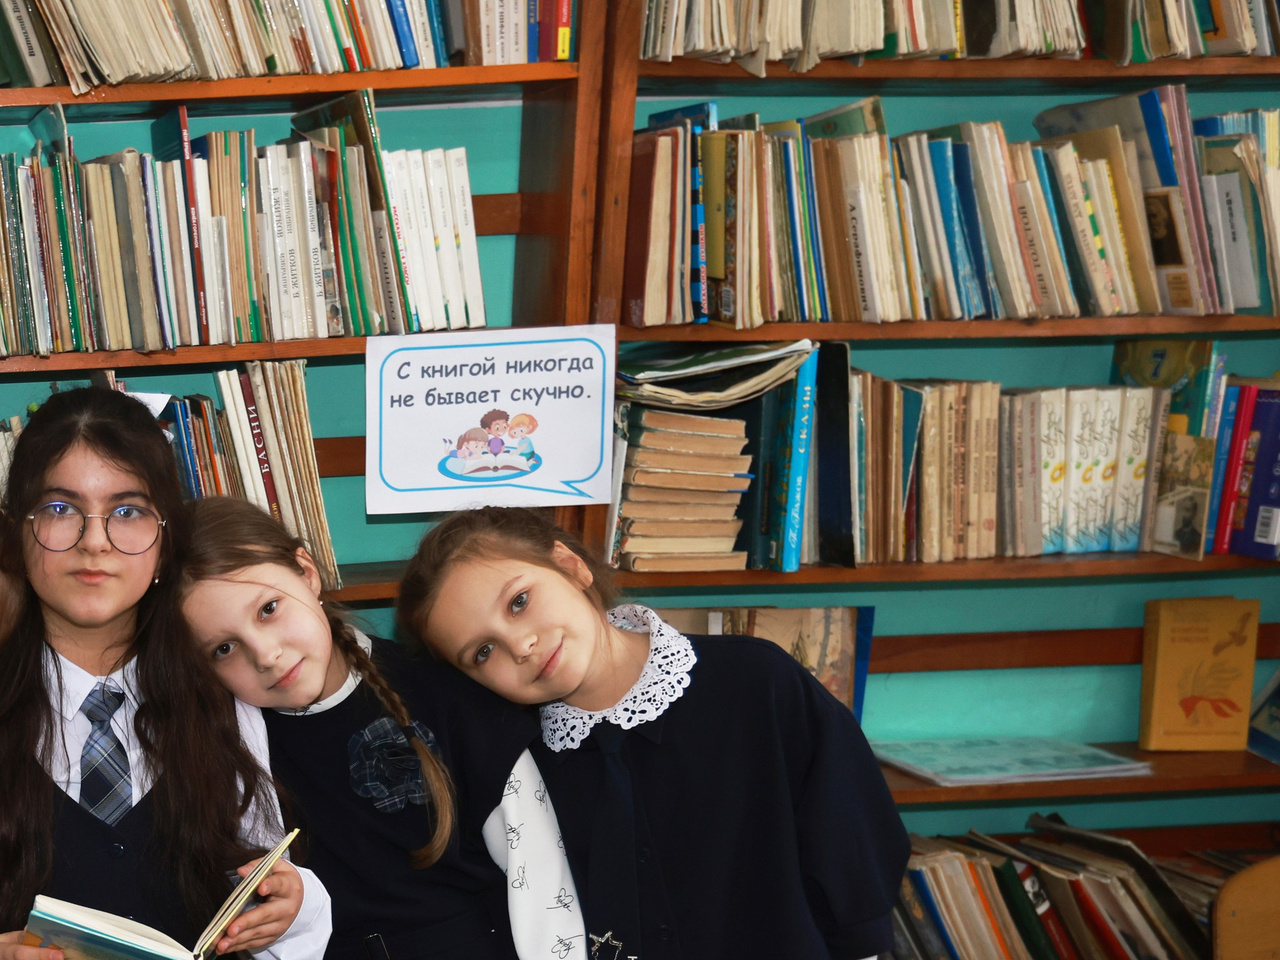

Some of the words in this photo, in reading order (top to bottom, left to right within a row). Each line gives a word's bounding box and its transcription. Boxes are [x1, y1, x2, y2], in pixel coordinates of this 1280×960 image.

[273, 197, 284, 240] ЖИТКОВ
[282, 190, 294, 235] ИЗБРАННОЕ
[306, 187, 317, 233] ИЗБРАННОЕ
[1017, 205, 1042, 270] ТОЛСТОЙ
[288, 248, 299, 289] ЖИТКОВ
[312, 246, 322, 288] ЖИТКОВ
[397, 361, 411, 380] С
[421, 356, 496, 379] книгой
[505, 356, 595, 375] никогда
[390, 393, 415, 409] не
[424, 387, 501, 408] бывает
[510, 383, 593, 407] скучно.
[246, 405, 271, 473] БАСНИ
[798, 385, 812, 454] СКАЗЫ
